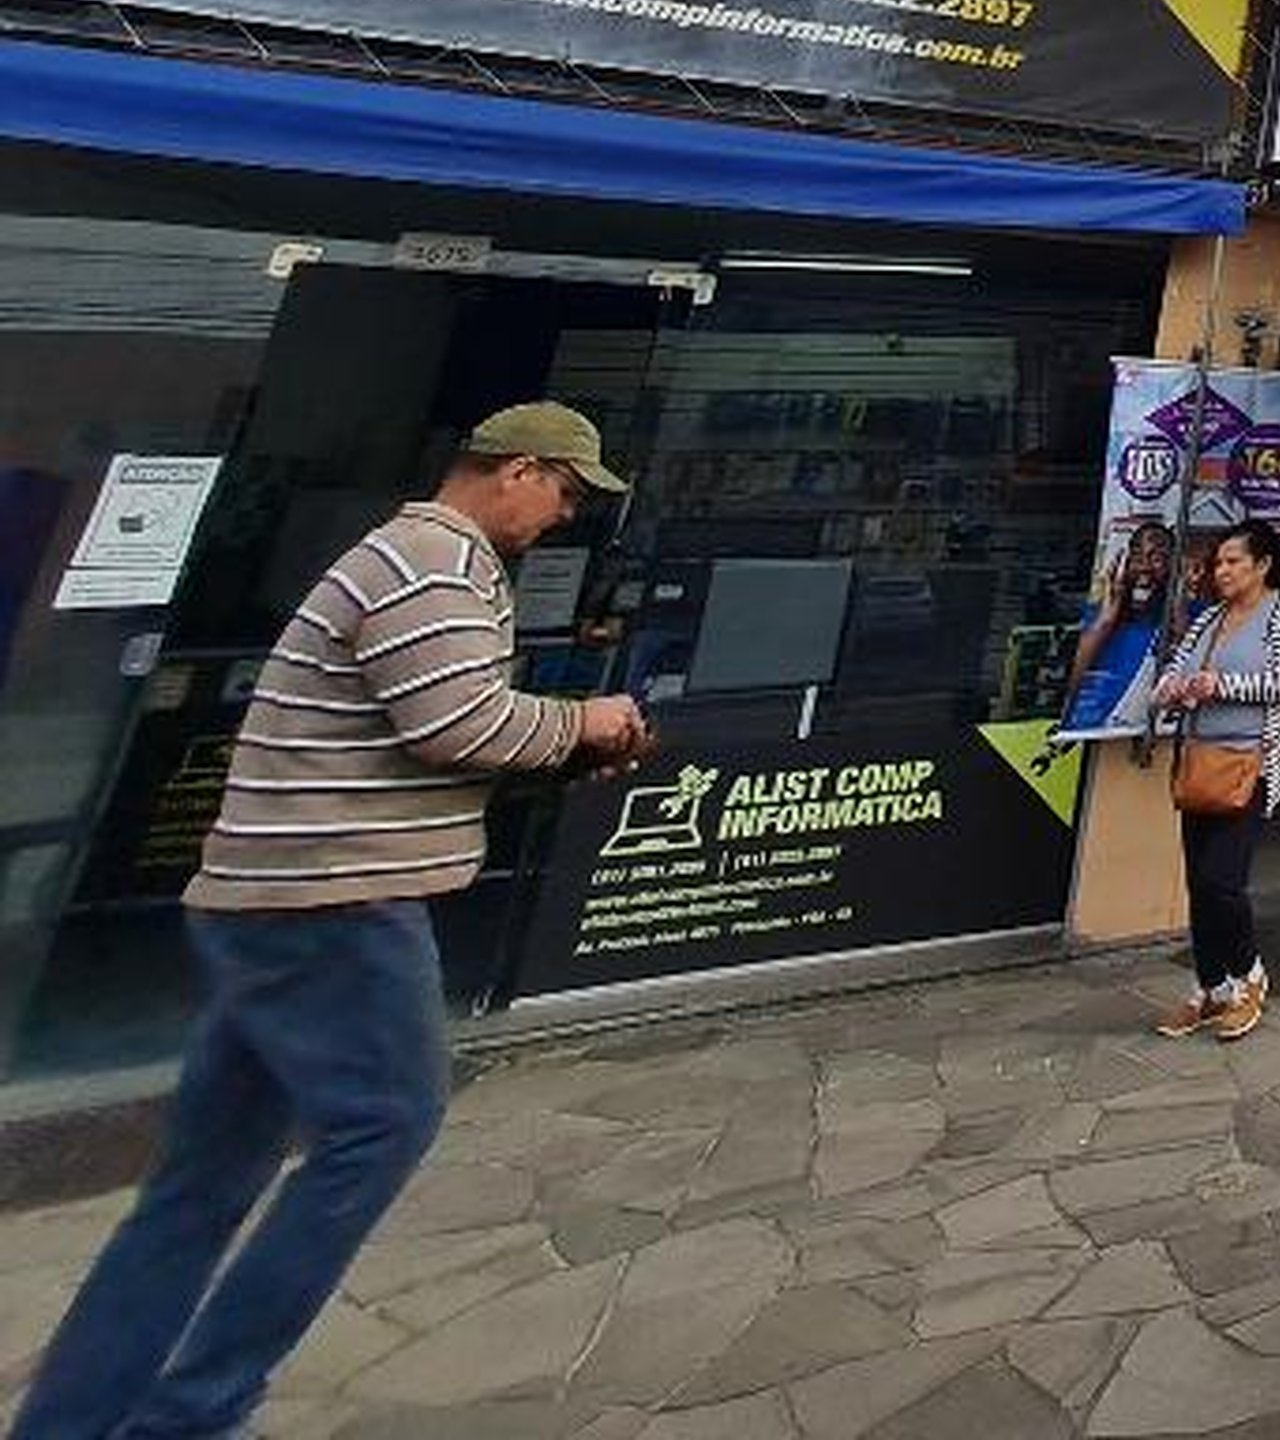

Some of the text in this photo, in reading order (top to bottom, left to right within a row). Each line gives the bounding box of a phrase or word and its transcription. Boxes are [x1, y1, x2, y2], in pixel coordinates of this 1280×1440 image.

[724, 760, 935, 807] ALIST COMP
[717, 790, 943, 841] INFORMATICA
